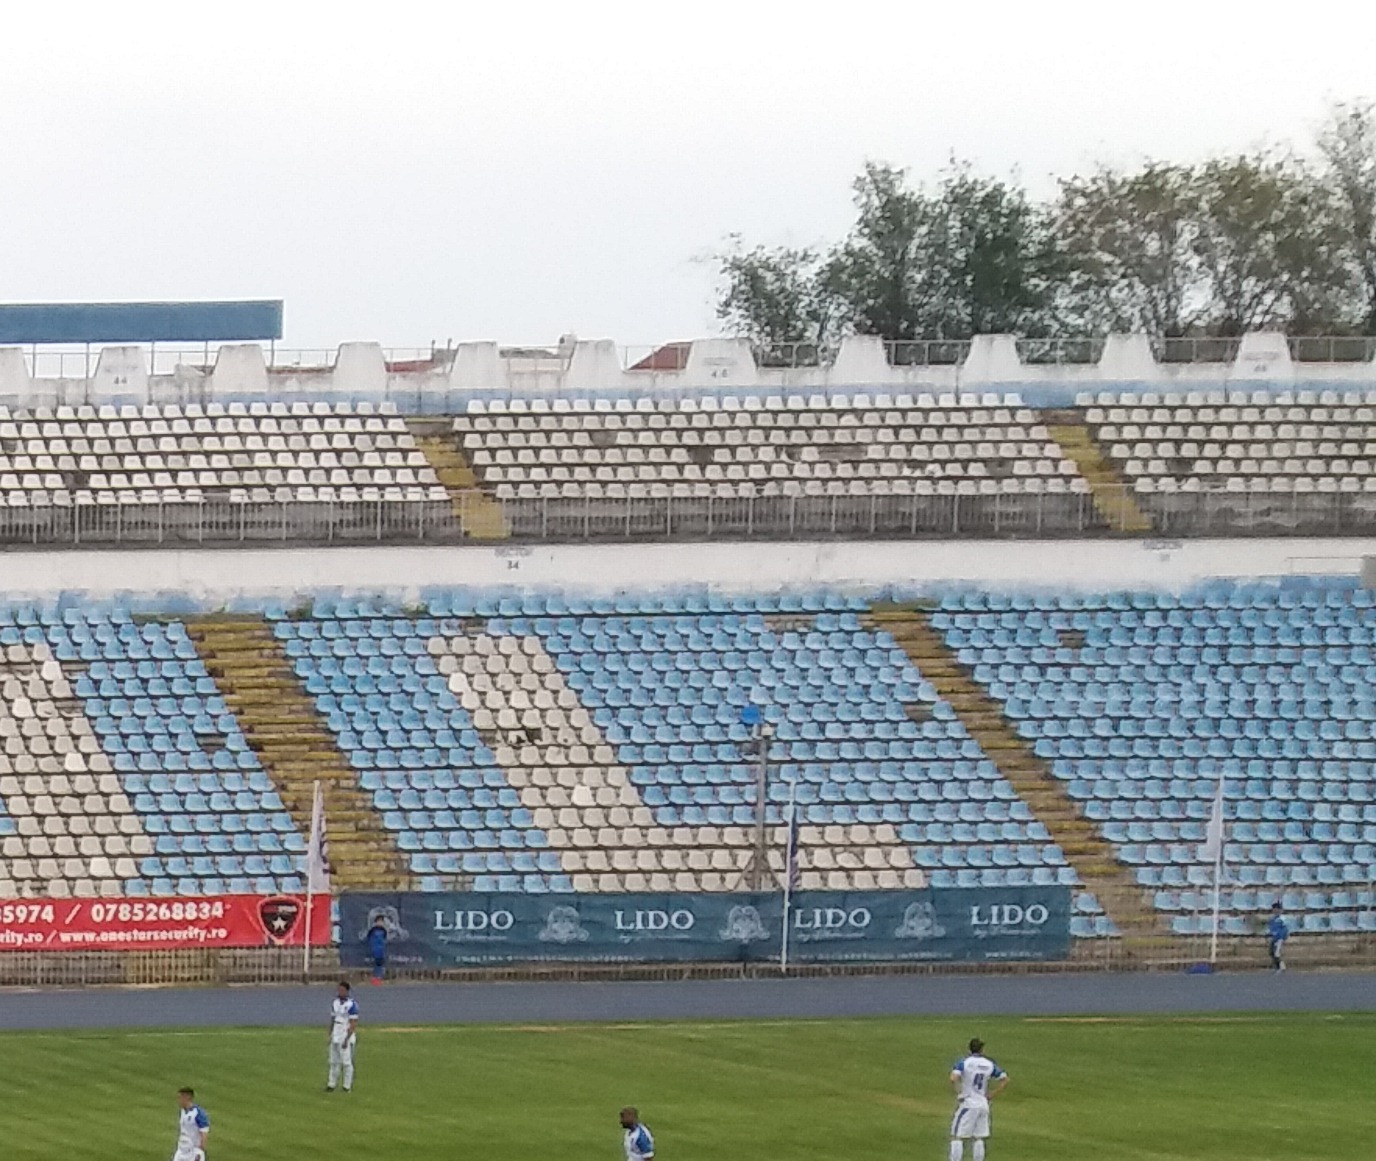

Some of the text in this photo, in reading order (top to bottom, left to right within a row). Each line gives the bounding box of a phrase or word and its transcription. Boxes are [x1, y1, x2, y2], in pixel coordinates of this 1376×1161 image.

[91, 901, 224, 923] 0785268834
[433, 910, 514, 930] LIDO
[614, 909, 694, 930] LIDO
[794, 907, 871, 928] LIDO
[971, 904, 1048, 925] LIDO
